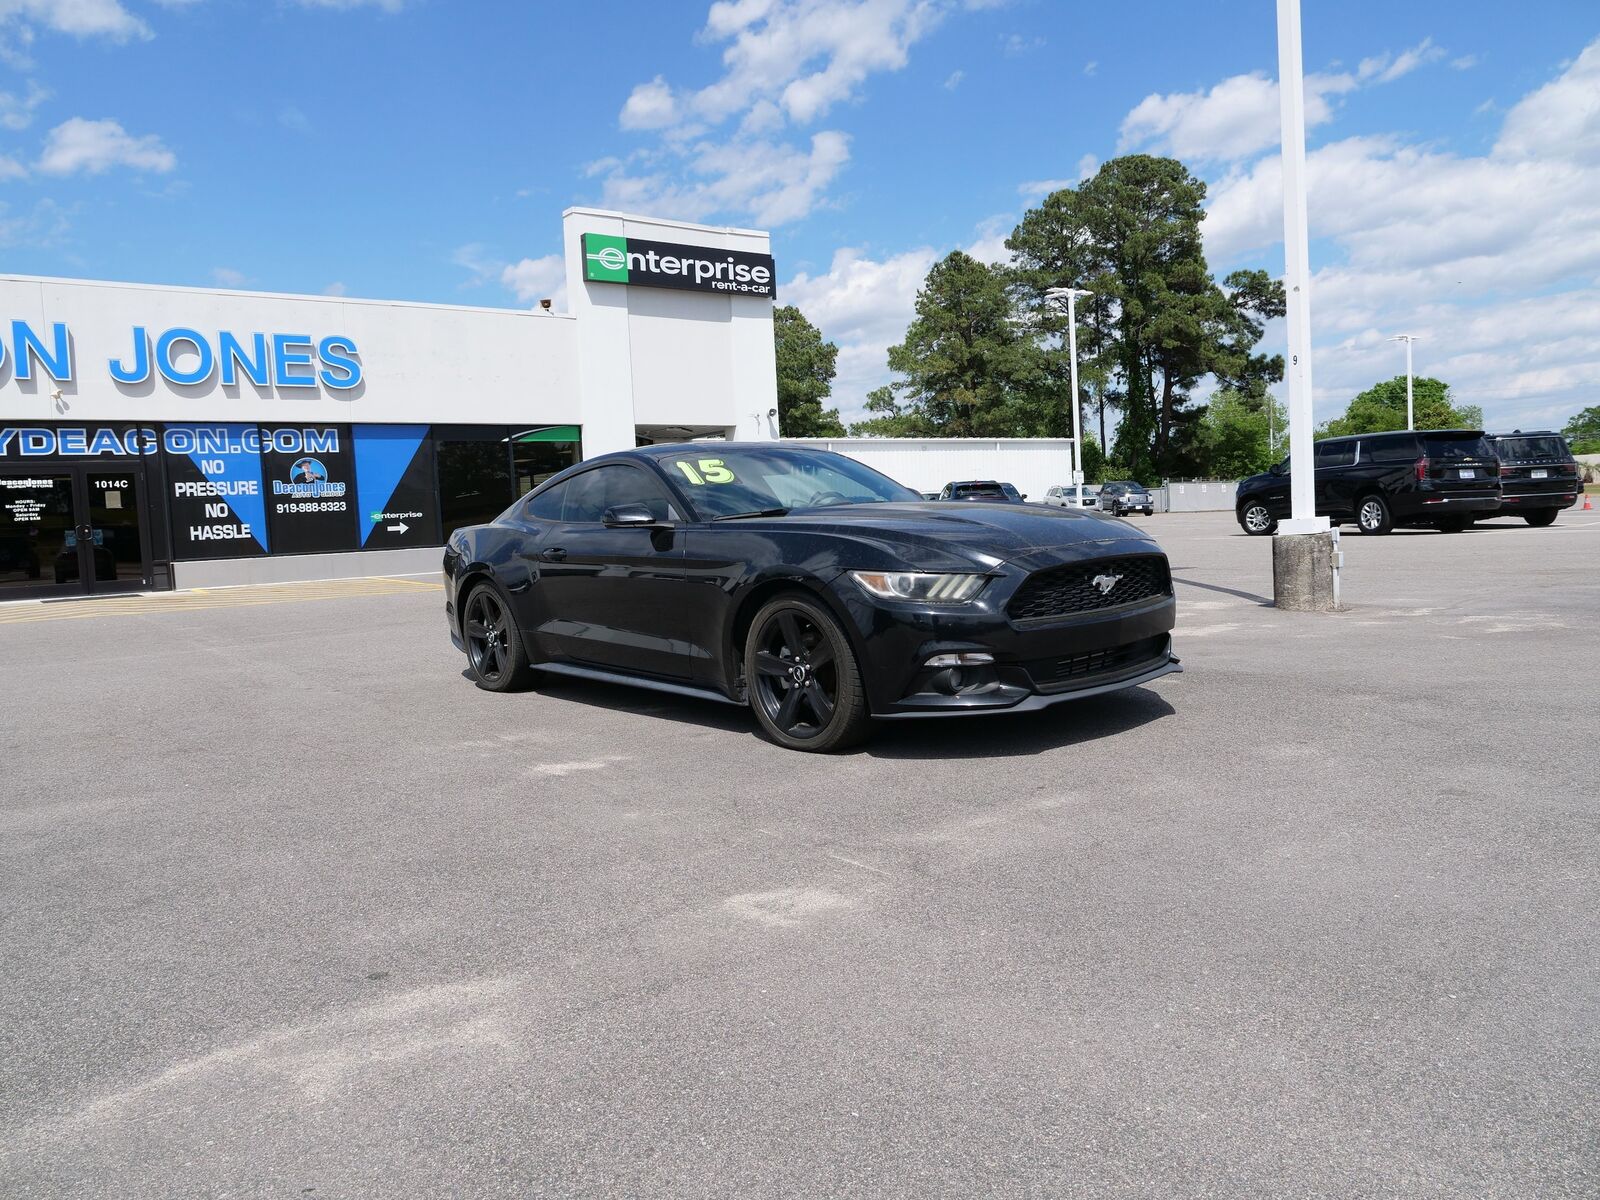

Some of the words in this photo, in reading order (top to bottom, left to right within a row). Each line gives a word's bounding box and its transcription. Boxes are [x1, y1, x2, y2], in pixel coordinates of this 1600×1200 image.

[586, 247, 770, 283] enterprise
[711, 280, 770, 294] rent-a-car
[0, 319, 73, 382] N
[107, 325, 363, 390] JONES
[1293, 355, 1298, 365] 9
[201, 460, 224, 474] NO
[676, 459, 735, 485] 15
[94, 480, 129, 488] 1014C
[174, 480, 258, 497] PRESSURE
[205, 503, 228, 518] NO
[276, 501, 347, 513] 919-988-9323
[370, 511, 423, 520] enterprise
[190, 523, 251, 541] HASSLE
